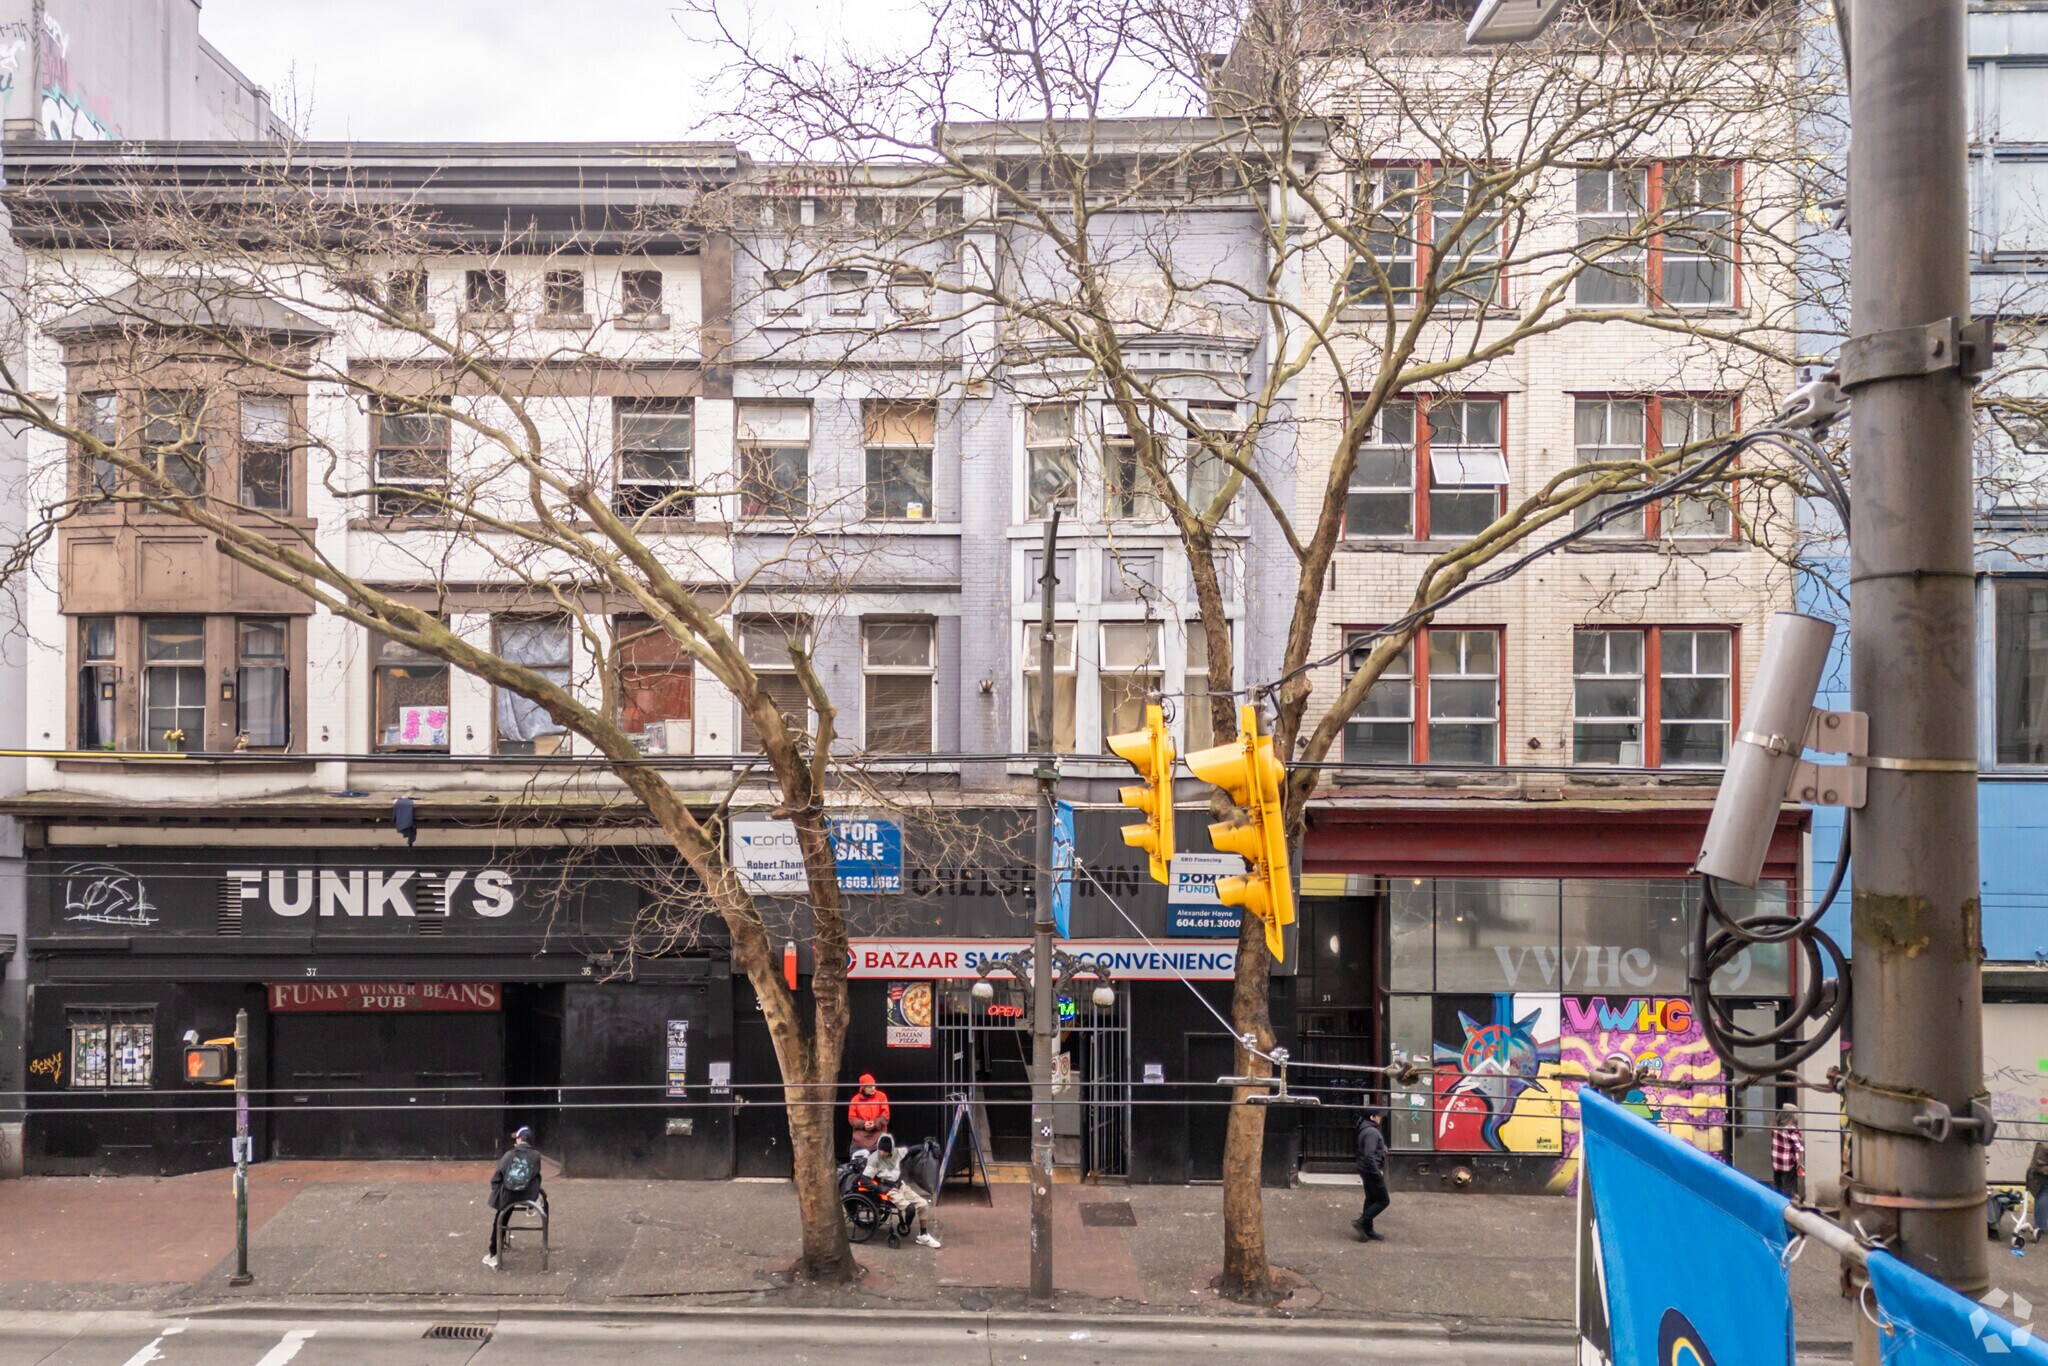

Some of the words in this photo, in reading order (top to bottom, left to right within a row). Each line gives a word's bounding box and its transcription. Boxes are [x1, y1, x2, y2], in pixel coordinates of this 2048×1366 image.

[752, 833, 800, 846] corbe
[840, 823, 878, 841] FOR
[835, 843, 884, 861] SALE
[746, 860, 777, 870] Robert
[753, 871, 777, 881] Marc
[912, 865, 1036, 897] CHELSE
[1079, 865, 1139, 898] INN
[226, 869, 515, 918] FUNKYS
[1176, 918, 1241, 928] 604.681.3000
[865, 952, 958, 969] BAZAAR
[1077, 952, 1238, 970] CONVENIENC
[1494, 946, 1657, 988] VWHC
[306, 968, 317, 977] 37
[581, 967, 592, 976] 35
[273, 984, 351, 1008] FUNKY
[359, 984, 416, 996] WINKER
[362, 997, 406, 1008] PUB
[987, 1005, 1023, 1018] OPEN
[1562, 996, 1693, 1034] VWHC
